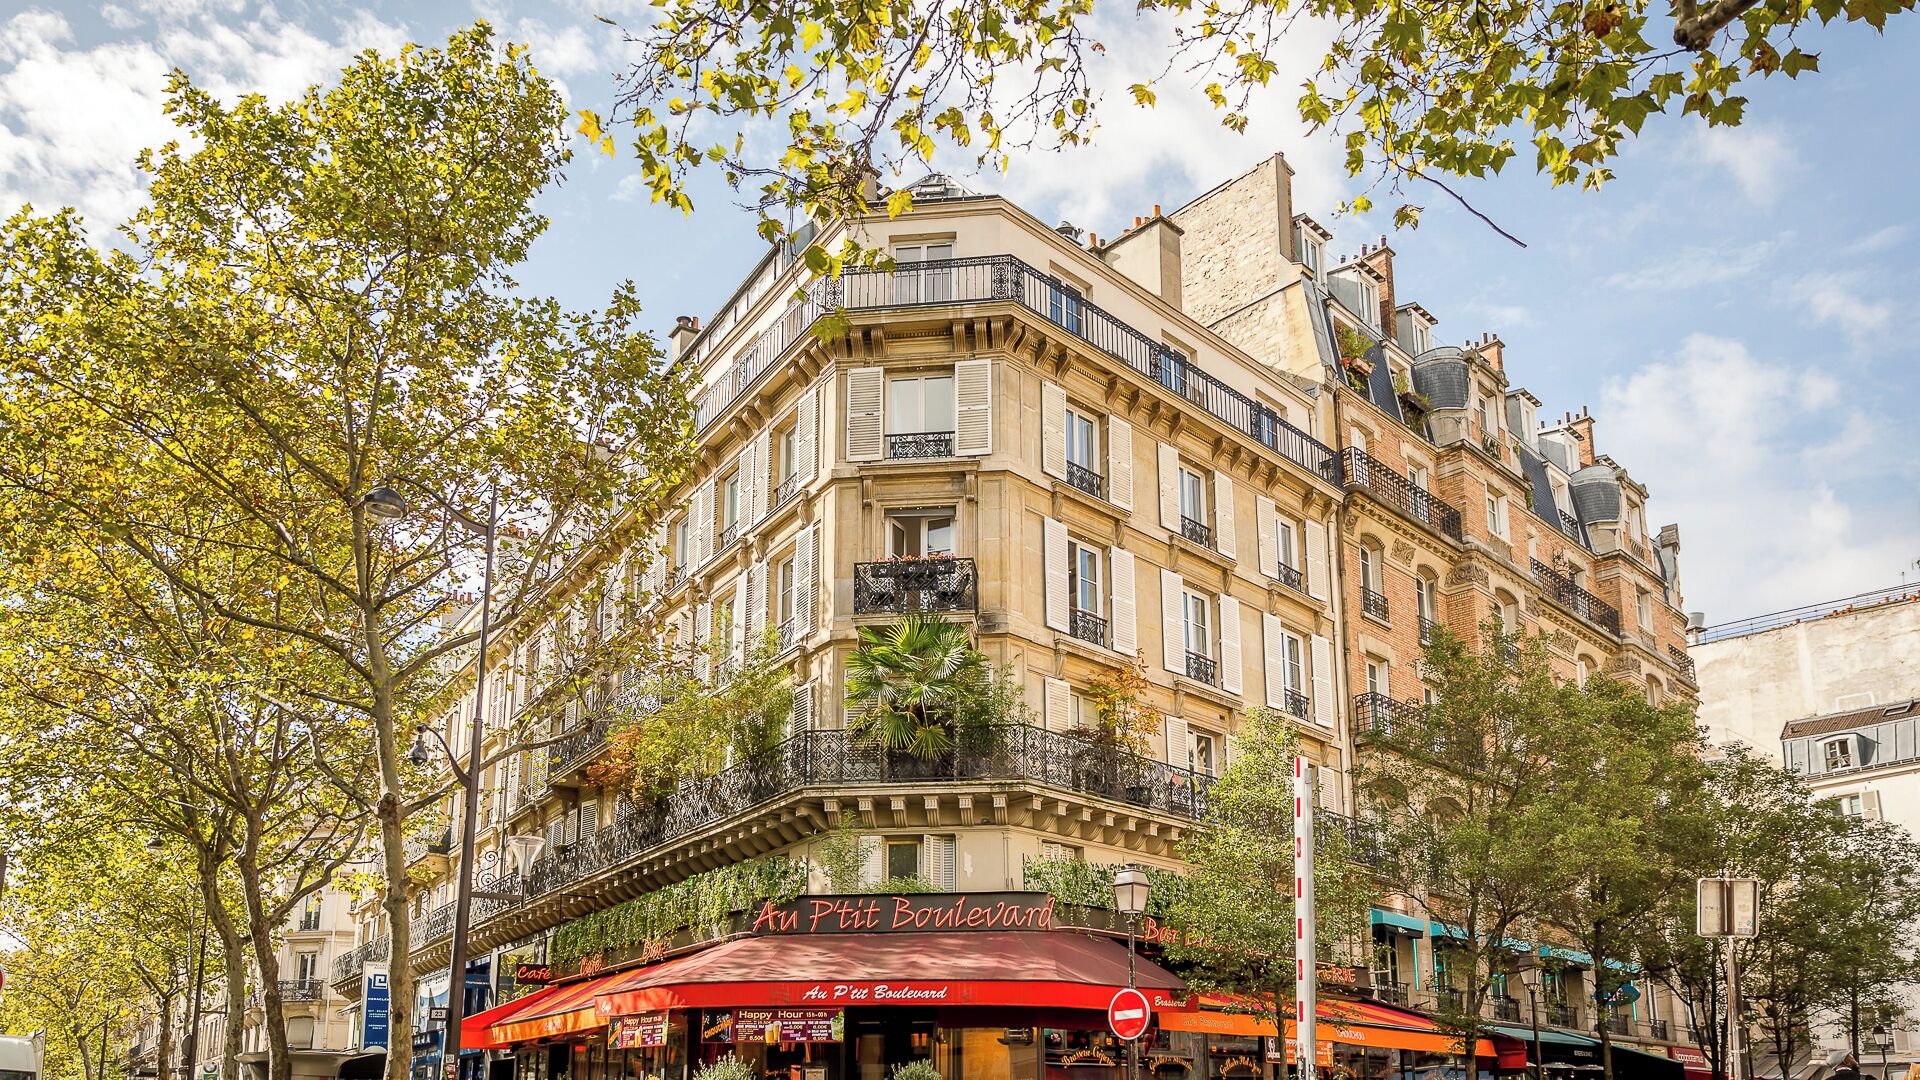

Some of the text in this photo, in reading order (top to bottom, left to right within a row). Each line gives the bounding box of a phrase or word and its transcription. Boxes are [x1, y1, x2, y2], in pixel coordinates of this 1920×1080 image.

[752, 896, 1056, 934] Au P'tit Boulevard
[518, 967, 551, 980] Café
[802, 984, 948, 1001] Au P'tit Boulevard
[1154, 995, 1187, 1007] Brasserie
[739, 1010, 772, 1020] Happy
[778, 1010, 803, 1019] Hour
[623, 1017, 640, 1026] Happy
